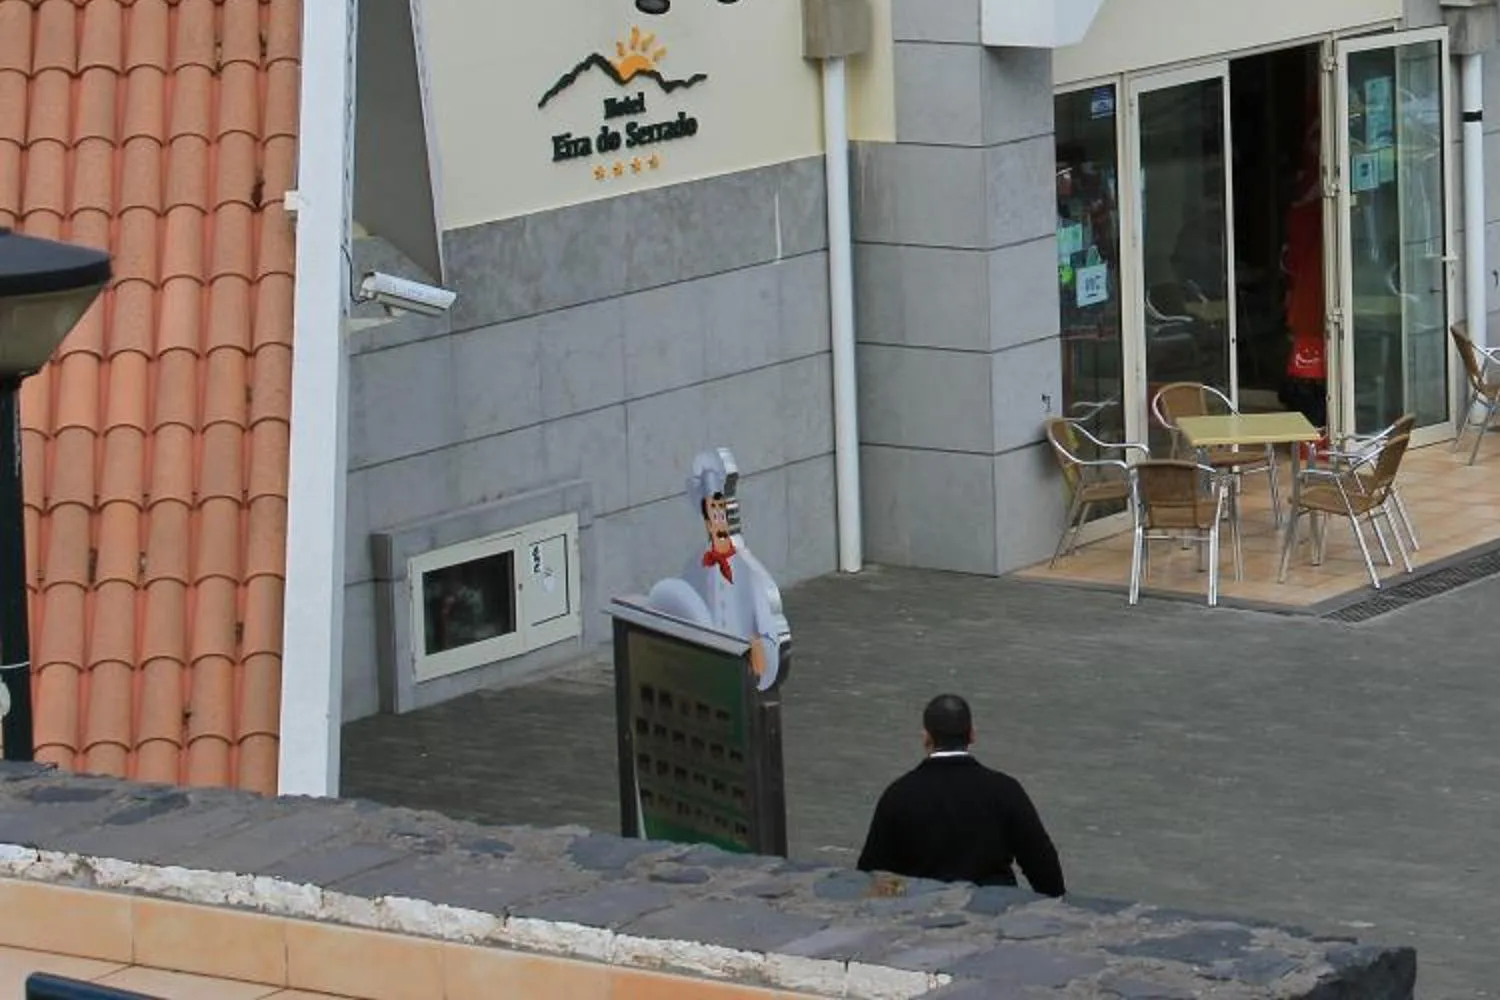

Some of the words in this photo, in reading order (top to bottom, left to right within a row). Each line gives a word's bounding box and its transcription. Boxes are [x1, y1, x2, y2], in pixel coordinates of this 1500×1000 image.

[603, 91, 647, 120] Hotel
[595, 125, 622, 153] do
[625, 111, 699, 149] Serrado
